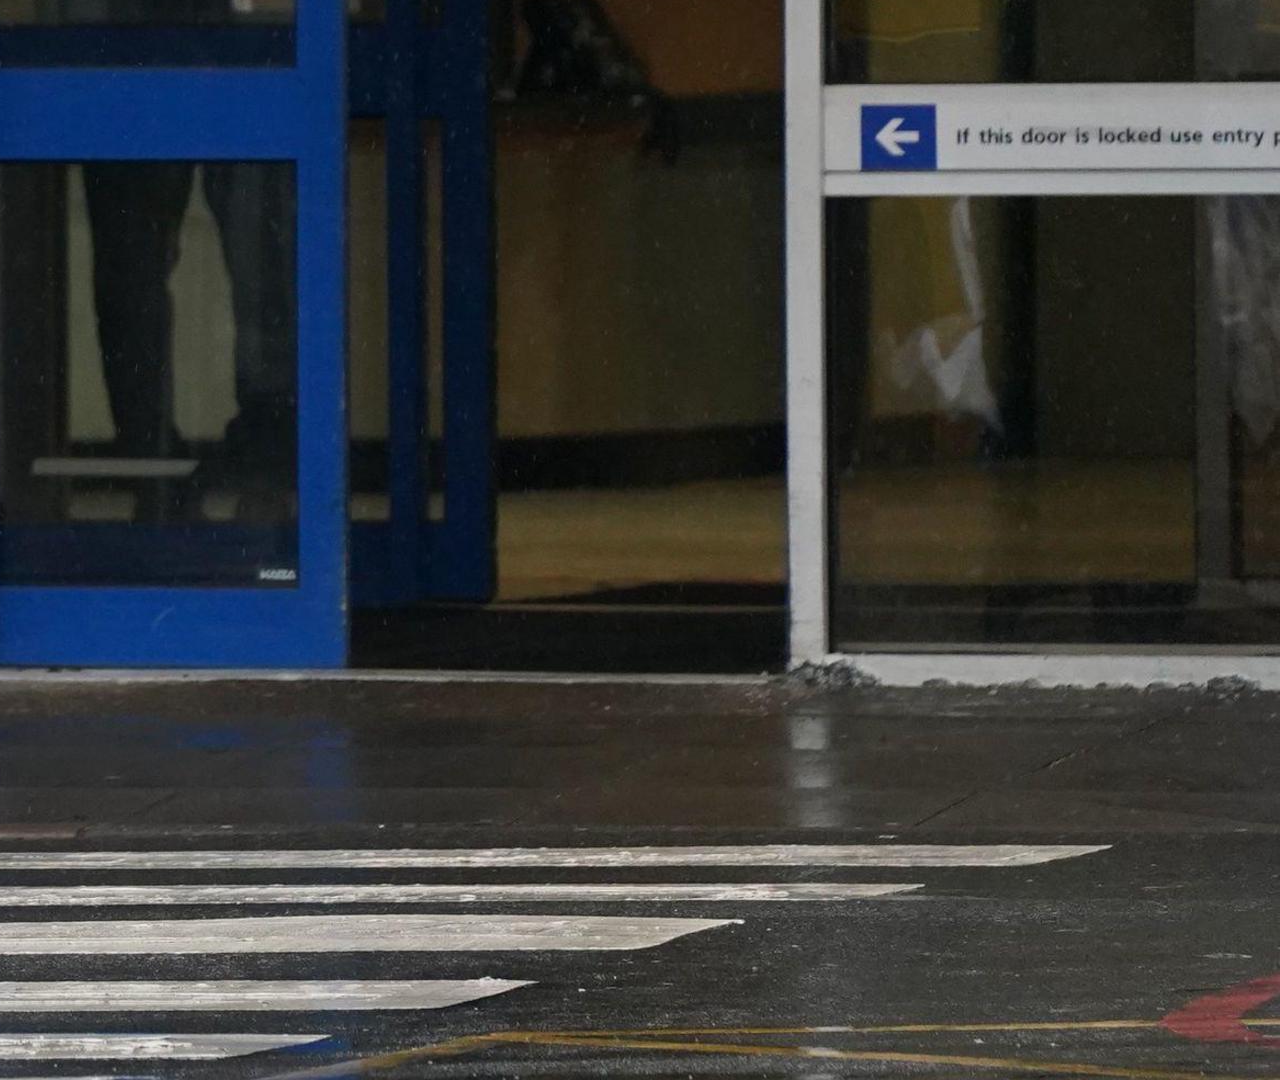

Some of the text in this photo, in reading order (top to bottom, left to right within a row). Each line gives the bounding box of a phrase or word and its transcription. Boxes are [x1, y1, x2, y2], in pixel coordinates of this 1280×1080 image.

[956, 127, 969, 144] If
[979, 127, 1013, 144] this
[1021, 127, 1067, 144] door
[1075, 127, 1089, 144] is
[1098, 126, 1162, 143] locked
[1170, 130, 1203, 143] use
[1212, 128, 1265, 147] entry
